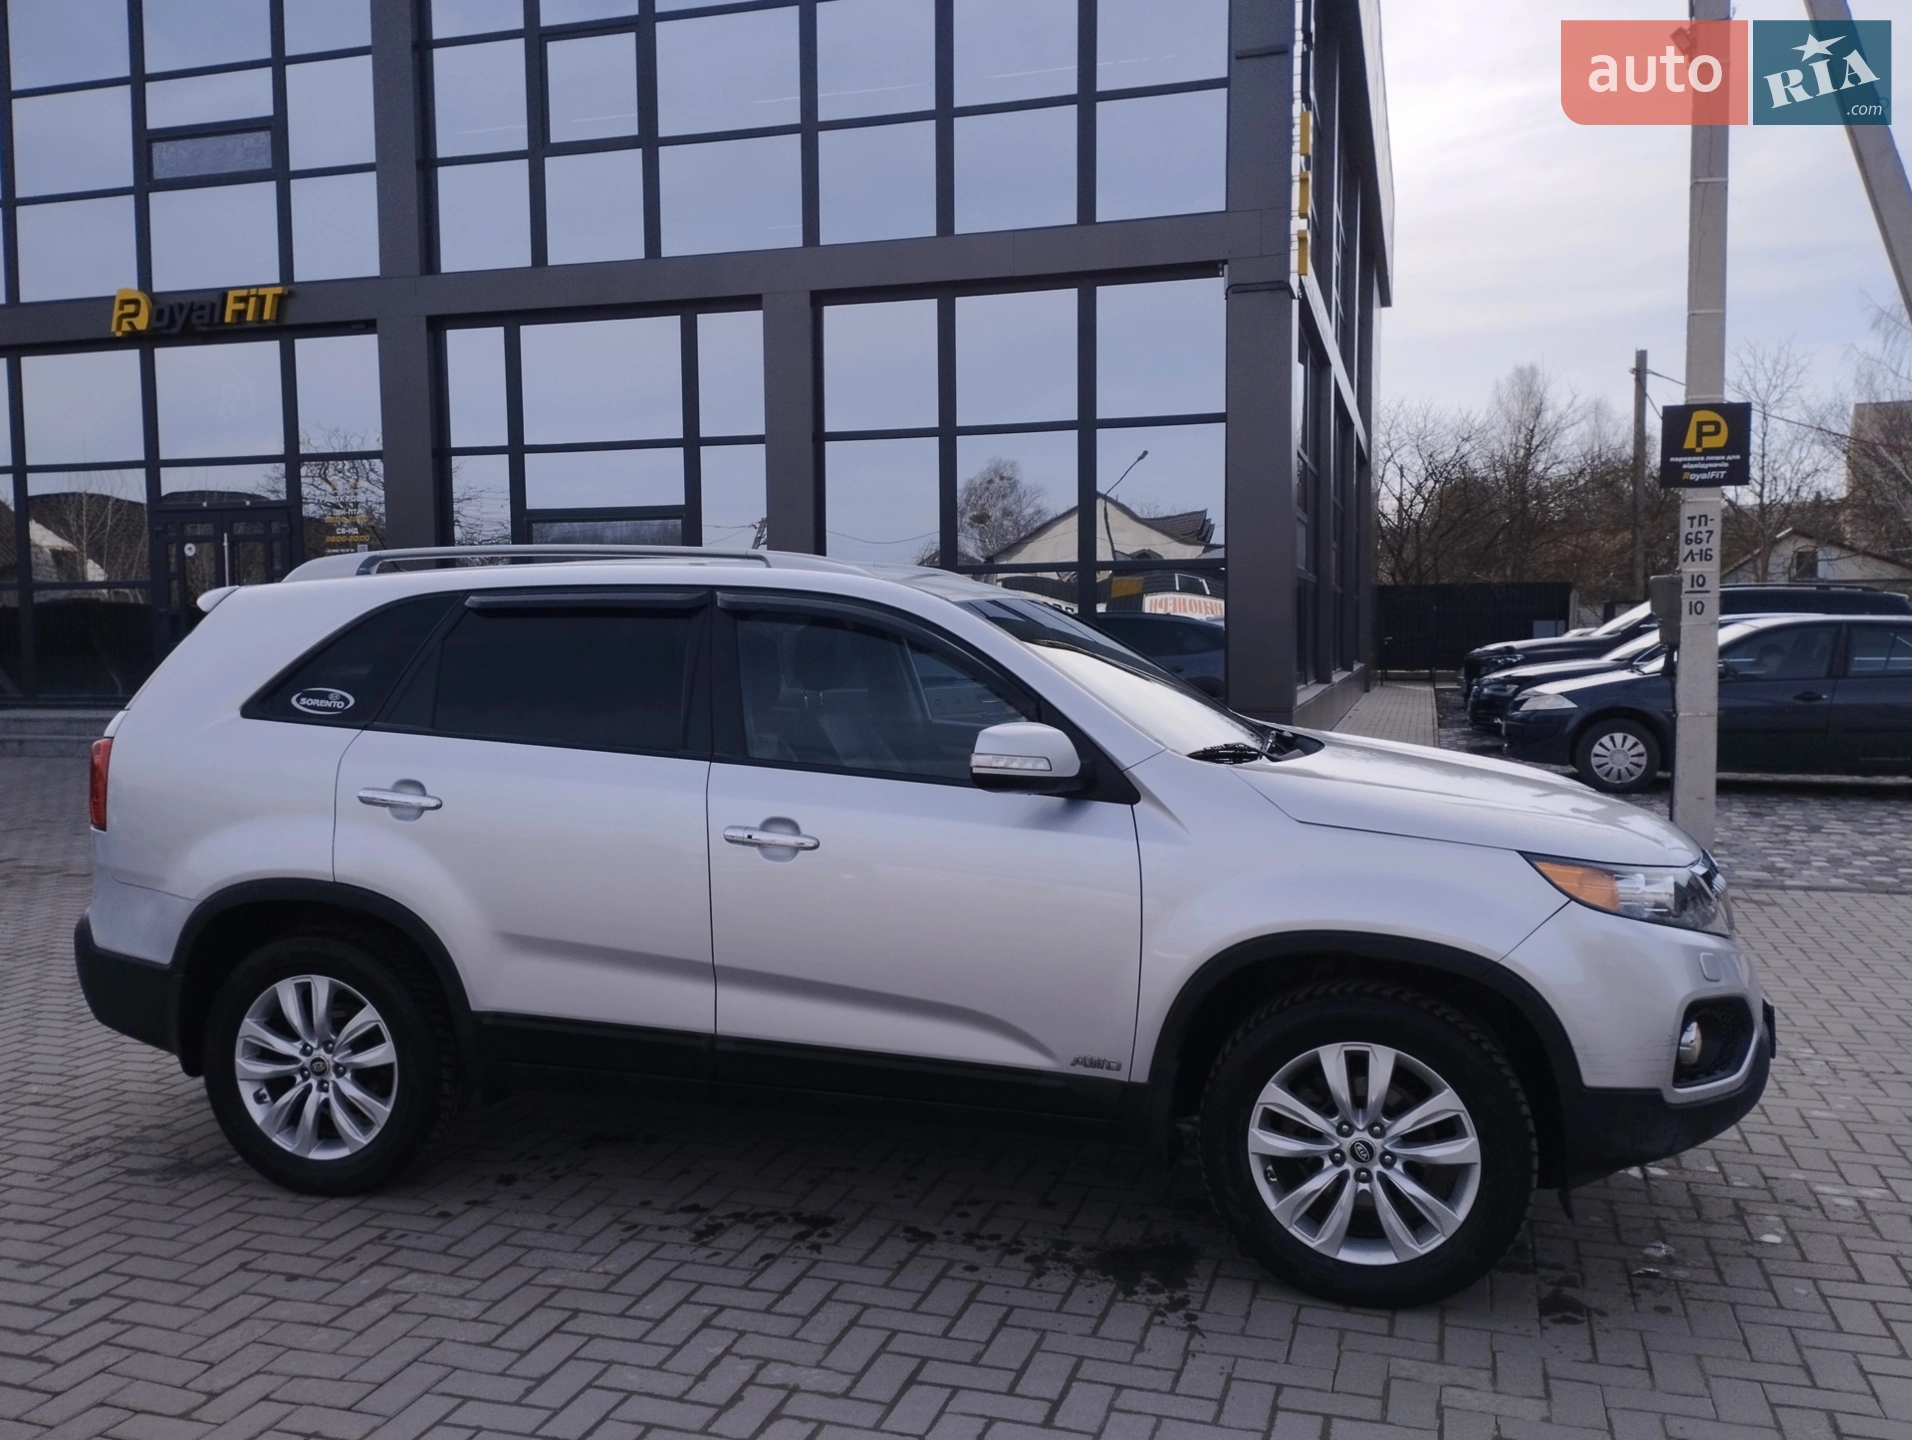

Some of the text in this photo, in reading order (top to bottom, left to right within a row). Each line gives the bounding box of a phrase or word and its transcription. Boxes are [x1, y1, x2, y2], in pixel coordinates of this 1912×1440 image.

[1684, 530, 1714, 546] 667
[1690, 574, 1706, 588] 10
[1689, 600, 1705, 615] 10
[300, 698, 344, 708] SORENTO
[1070, 1055, 1121, 1071] AWD
